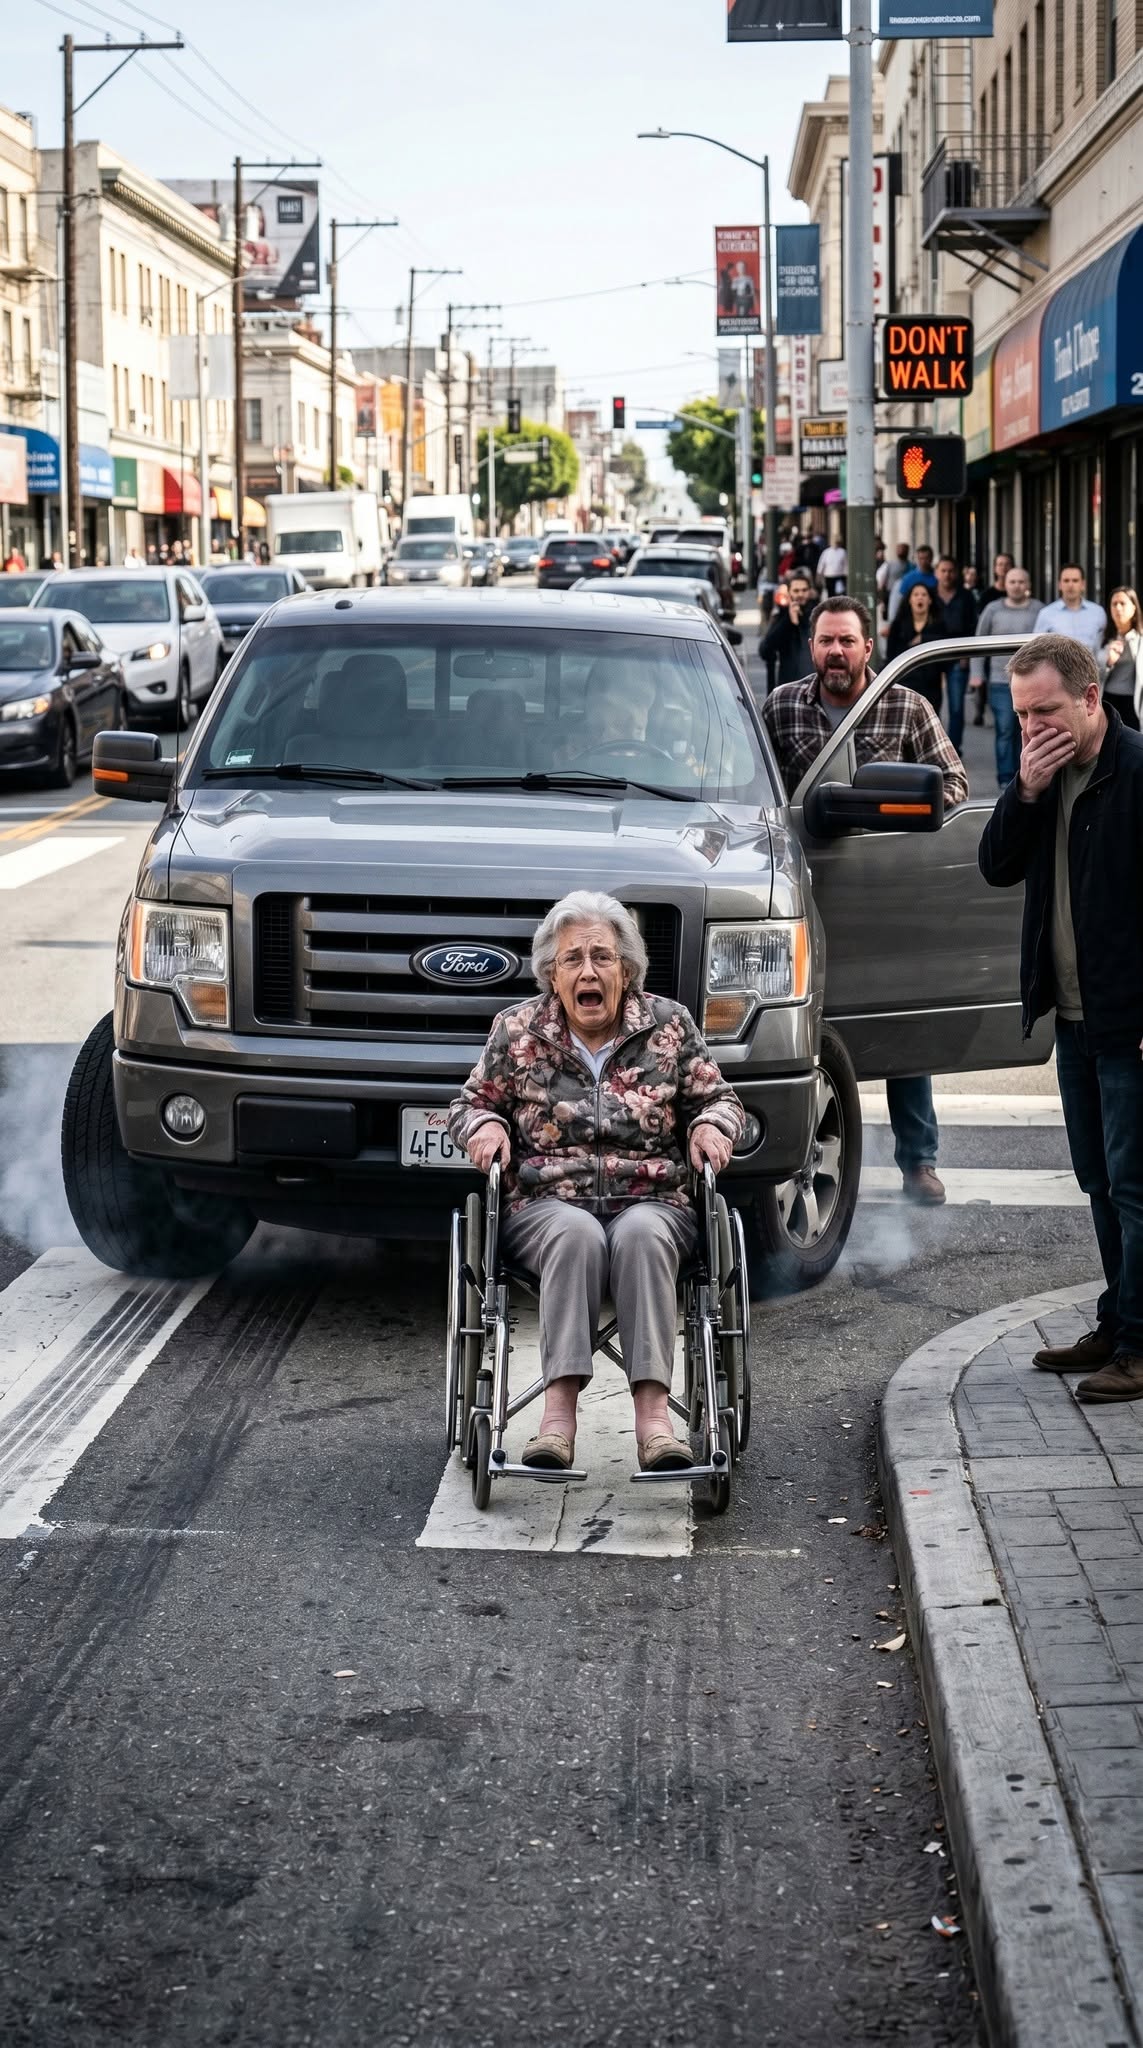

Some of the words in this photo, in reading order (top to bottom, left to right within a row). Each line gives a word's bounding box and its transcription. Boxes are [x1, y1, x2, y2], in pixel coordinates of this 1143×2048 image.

[889, 325, 968, 355] DON'T
[889, 360, 967, 389] WALK
[440, 951, 490, 973] Ford
[409, 1130, 465, 1159] 4FG
